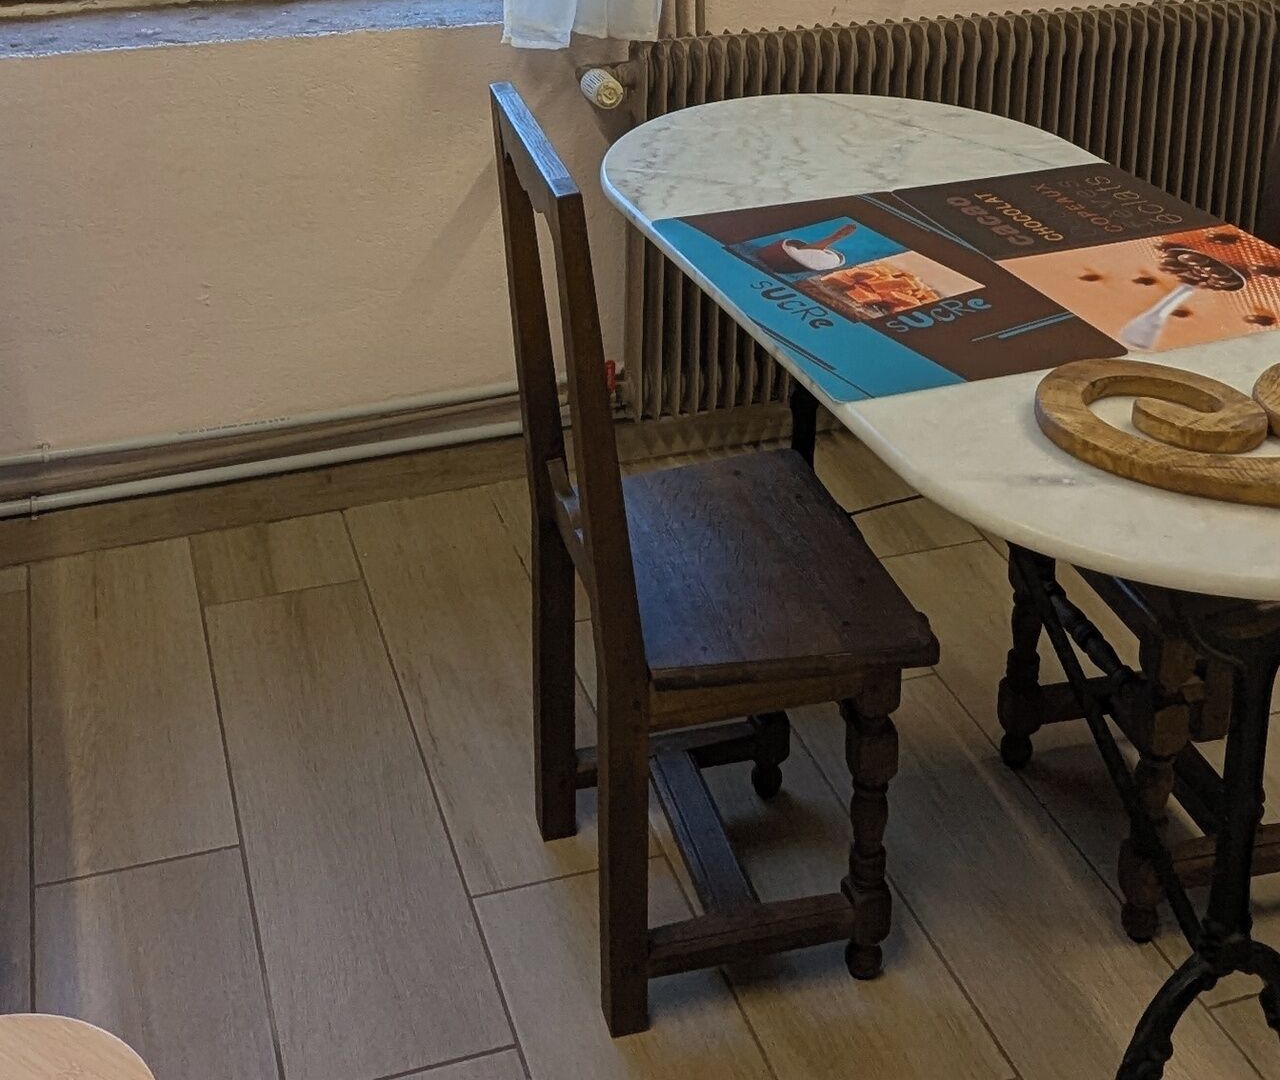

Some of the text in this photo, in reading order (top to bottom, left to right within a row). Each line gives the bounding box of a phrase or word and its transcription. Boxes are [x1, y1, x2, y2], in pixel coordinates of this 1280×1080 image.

[946, 196, 1035, 246] cacao
[974, 191, 1064, 242] CHOCOLAT
[1031, 182, 1124, 233] COPEAUX
